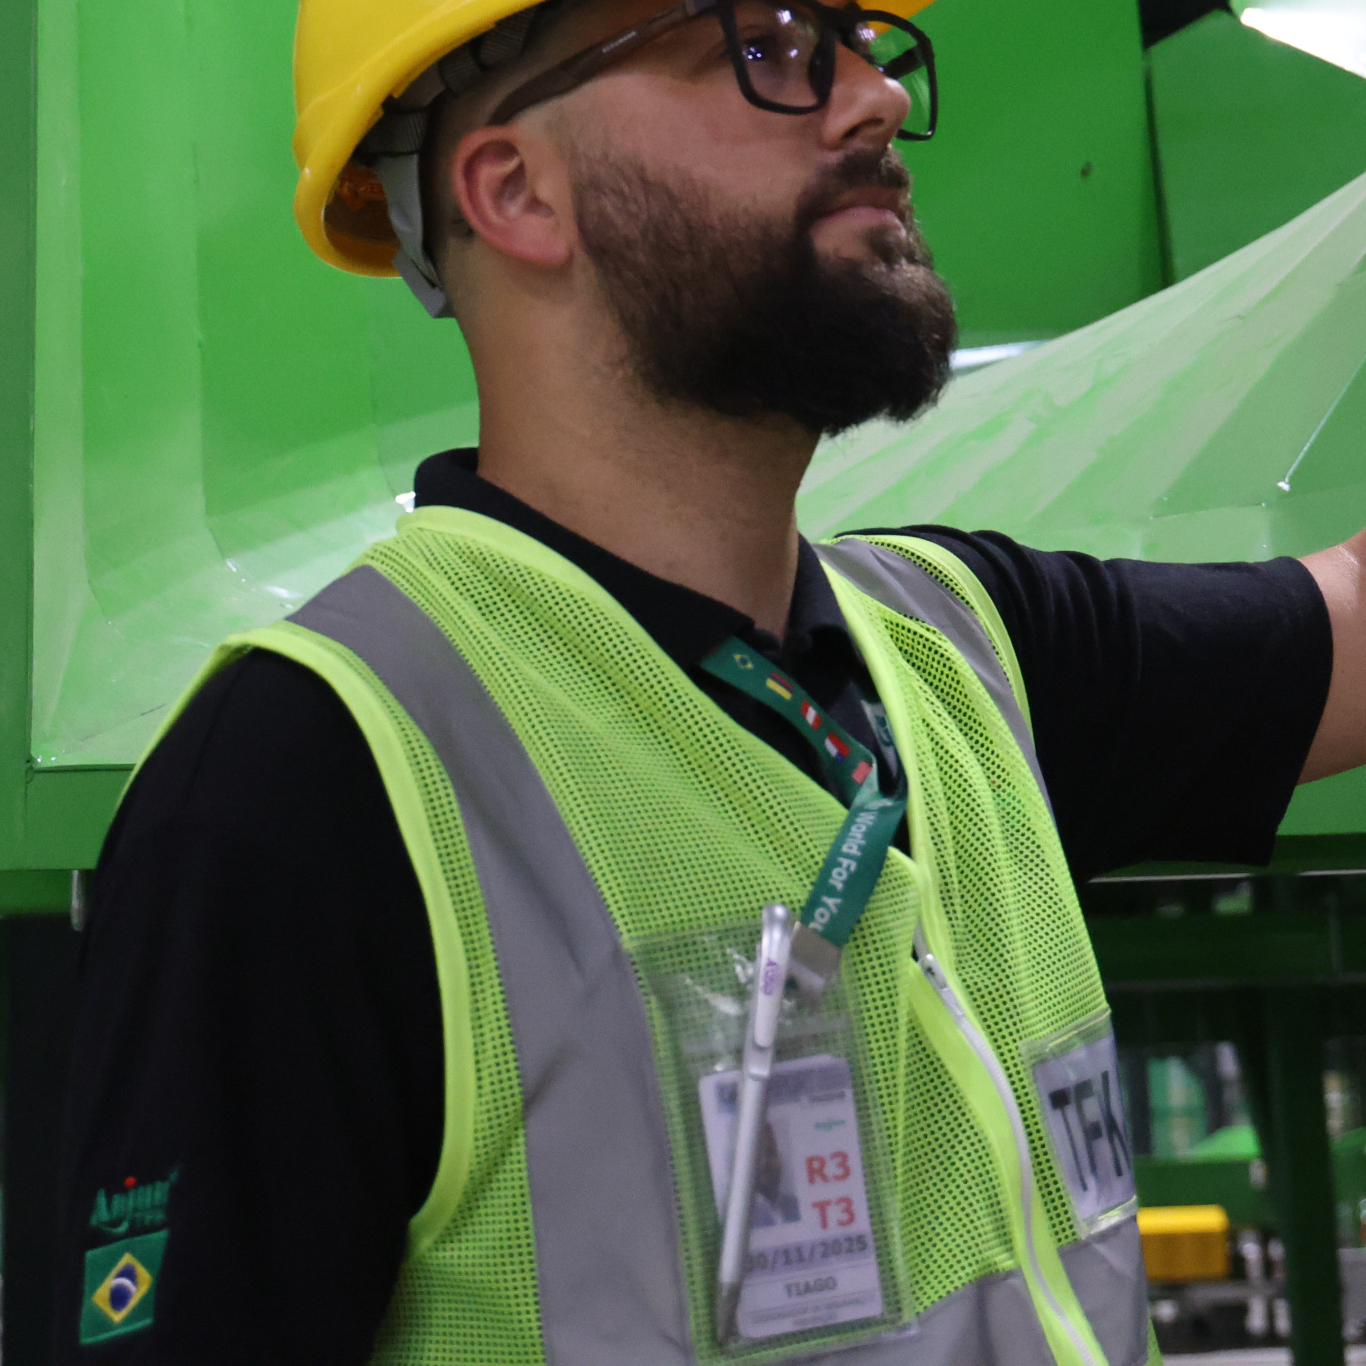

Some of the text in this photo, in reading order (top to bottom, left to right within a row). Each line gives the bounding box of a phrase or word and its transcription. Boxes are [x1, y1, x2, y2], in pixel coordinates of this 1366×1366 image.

[842, 811, 879, 856] World
[828, 856, 857, 892] For
[806, 1151, 851, 1185] R3
[812, 1196, 856, 1230] T3
